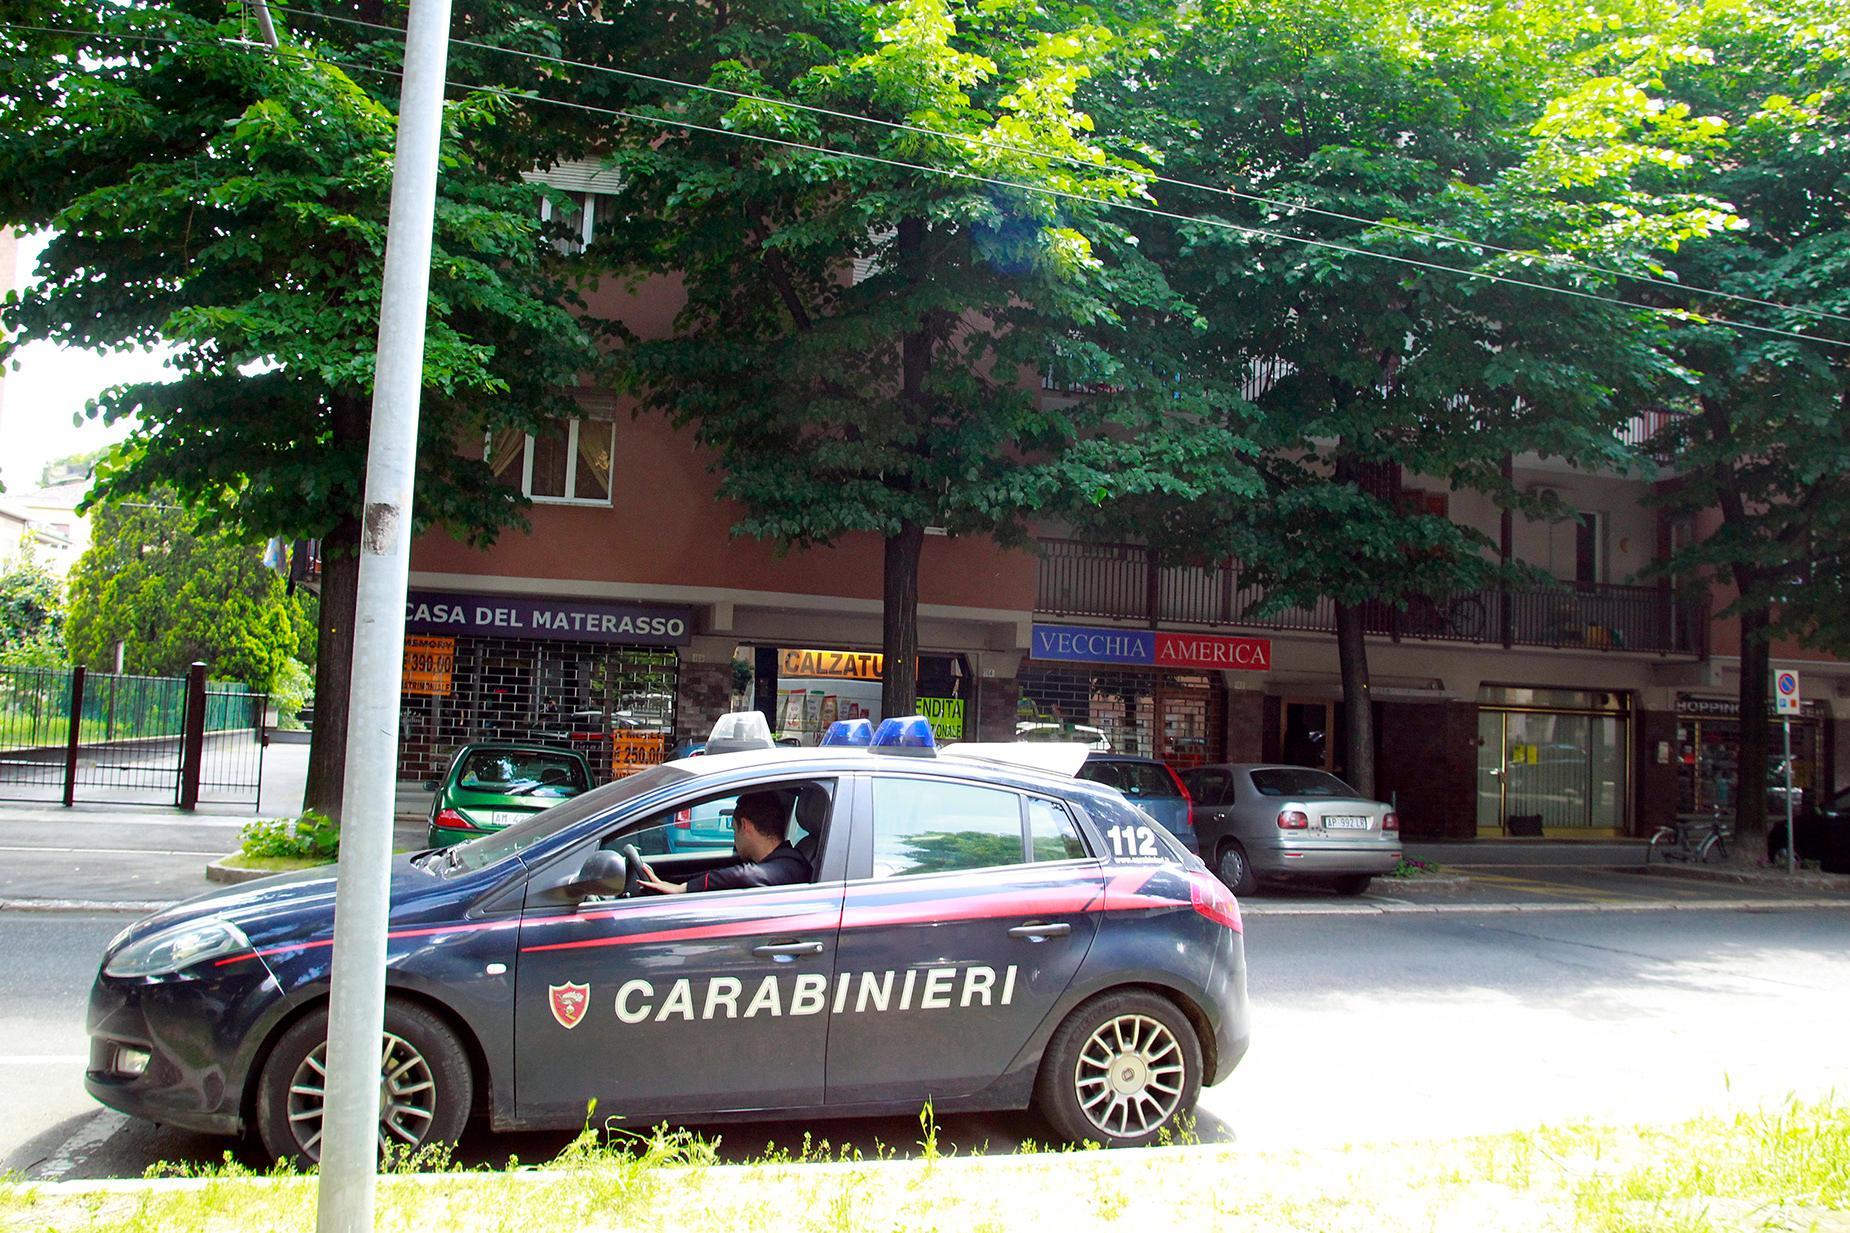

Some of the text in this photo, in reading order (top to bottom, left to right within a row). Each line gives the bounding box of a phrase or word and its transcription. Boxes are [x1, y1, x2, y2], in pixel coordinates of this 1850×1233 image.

[406, 603, 684, 637] CASA DEL MATERASSO
[1040, 632, 1266, 665] VECCHIA AMERICA
[1107, 825, 1158, 856] 112
[615, 965, 1018, 1023] CARABINIERI
